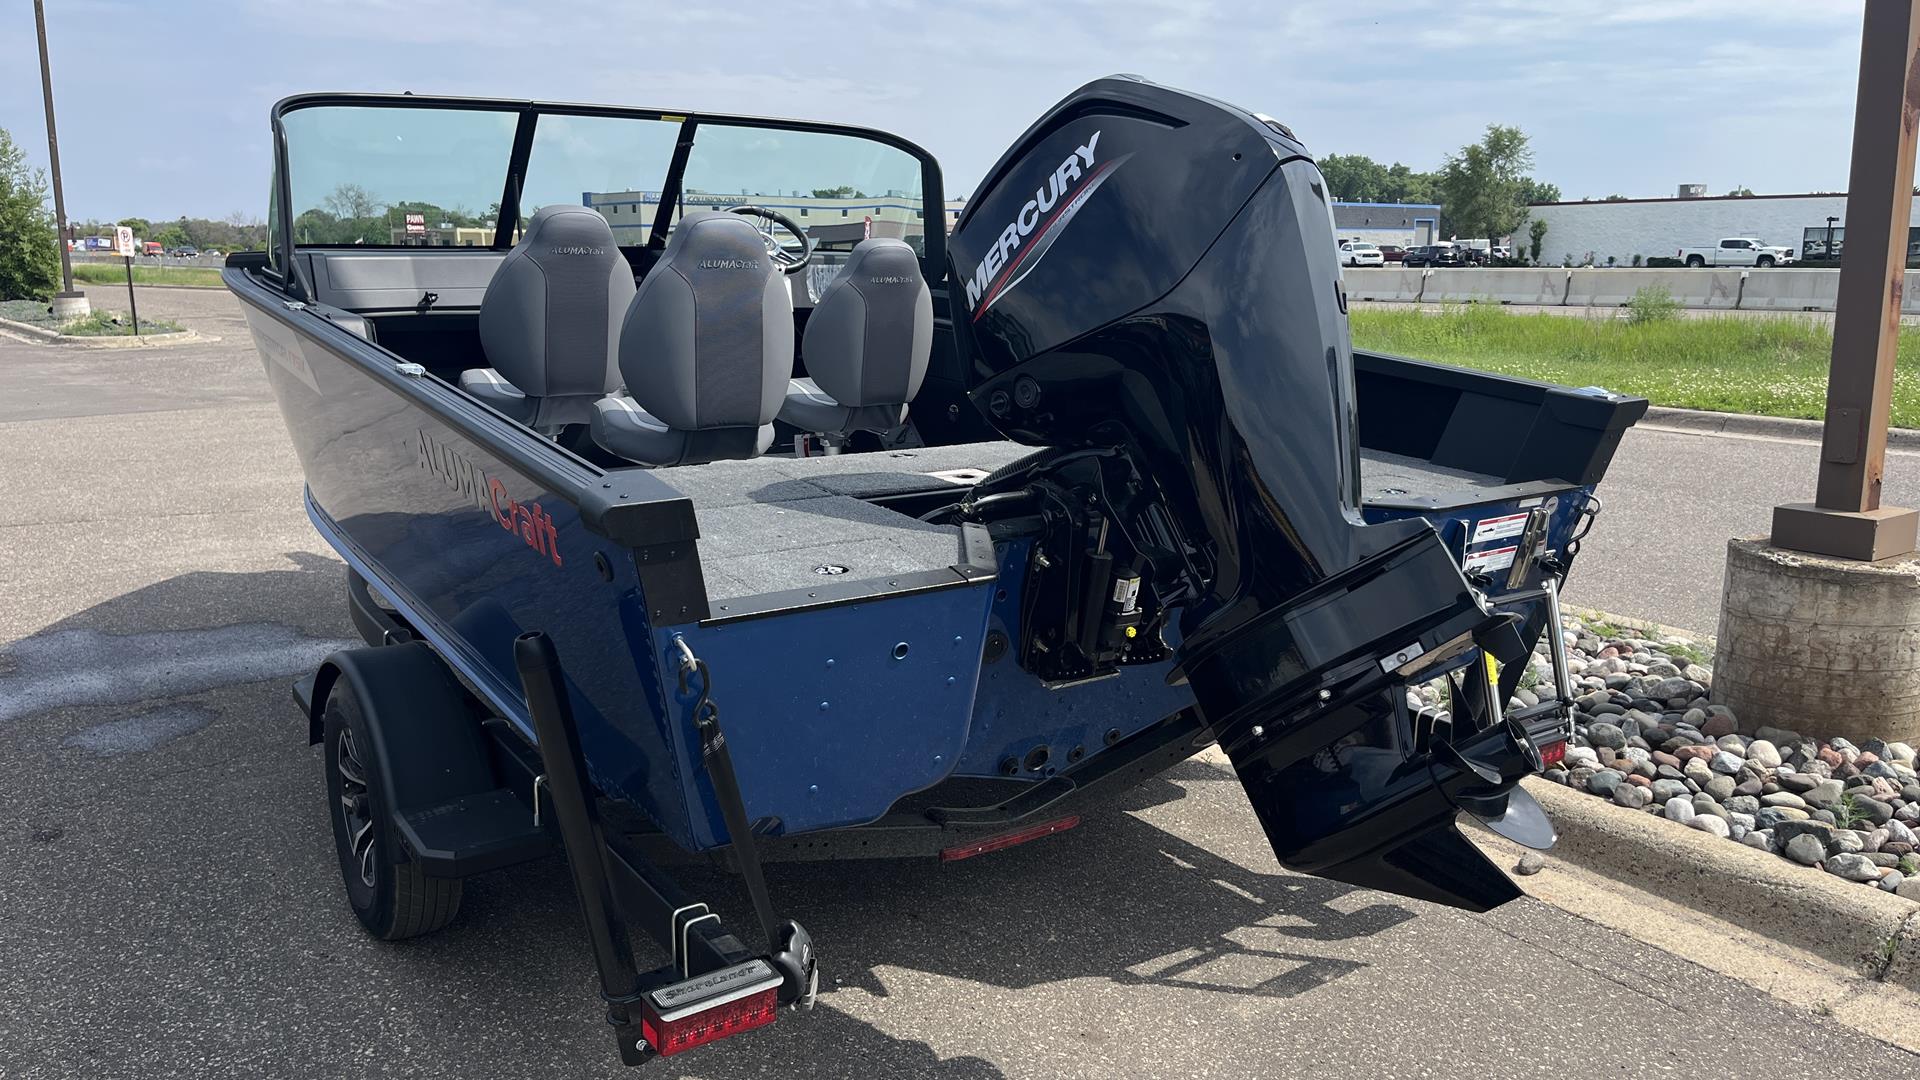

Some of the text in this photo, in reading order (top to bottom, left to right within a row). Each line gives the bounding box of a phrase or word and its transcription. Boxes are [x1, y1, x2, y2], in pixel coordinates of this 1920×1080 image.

[406, 214, 424, 224] PAWN
[965, 130, 1101, 312] MERCURY
[416, 428, 562, 567] ALUMACraft
